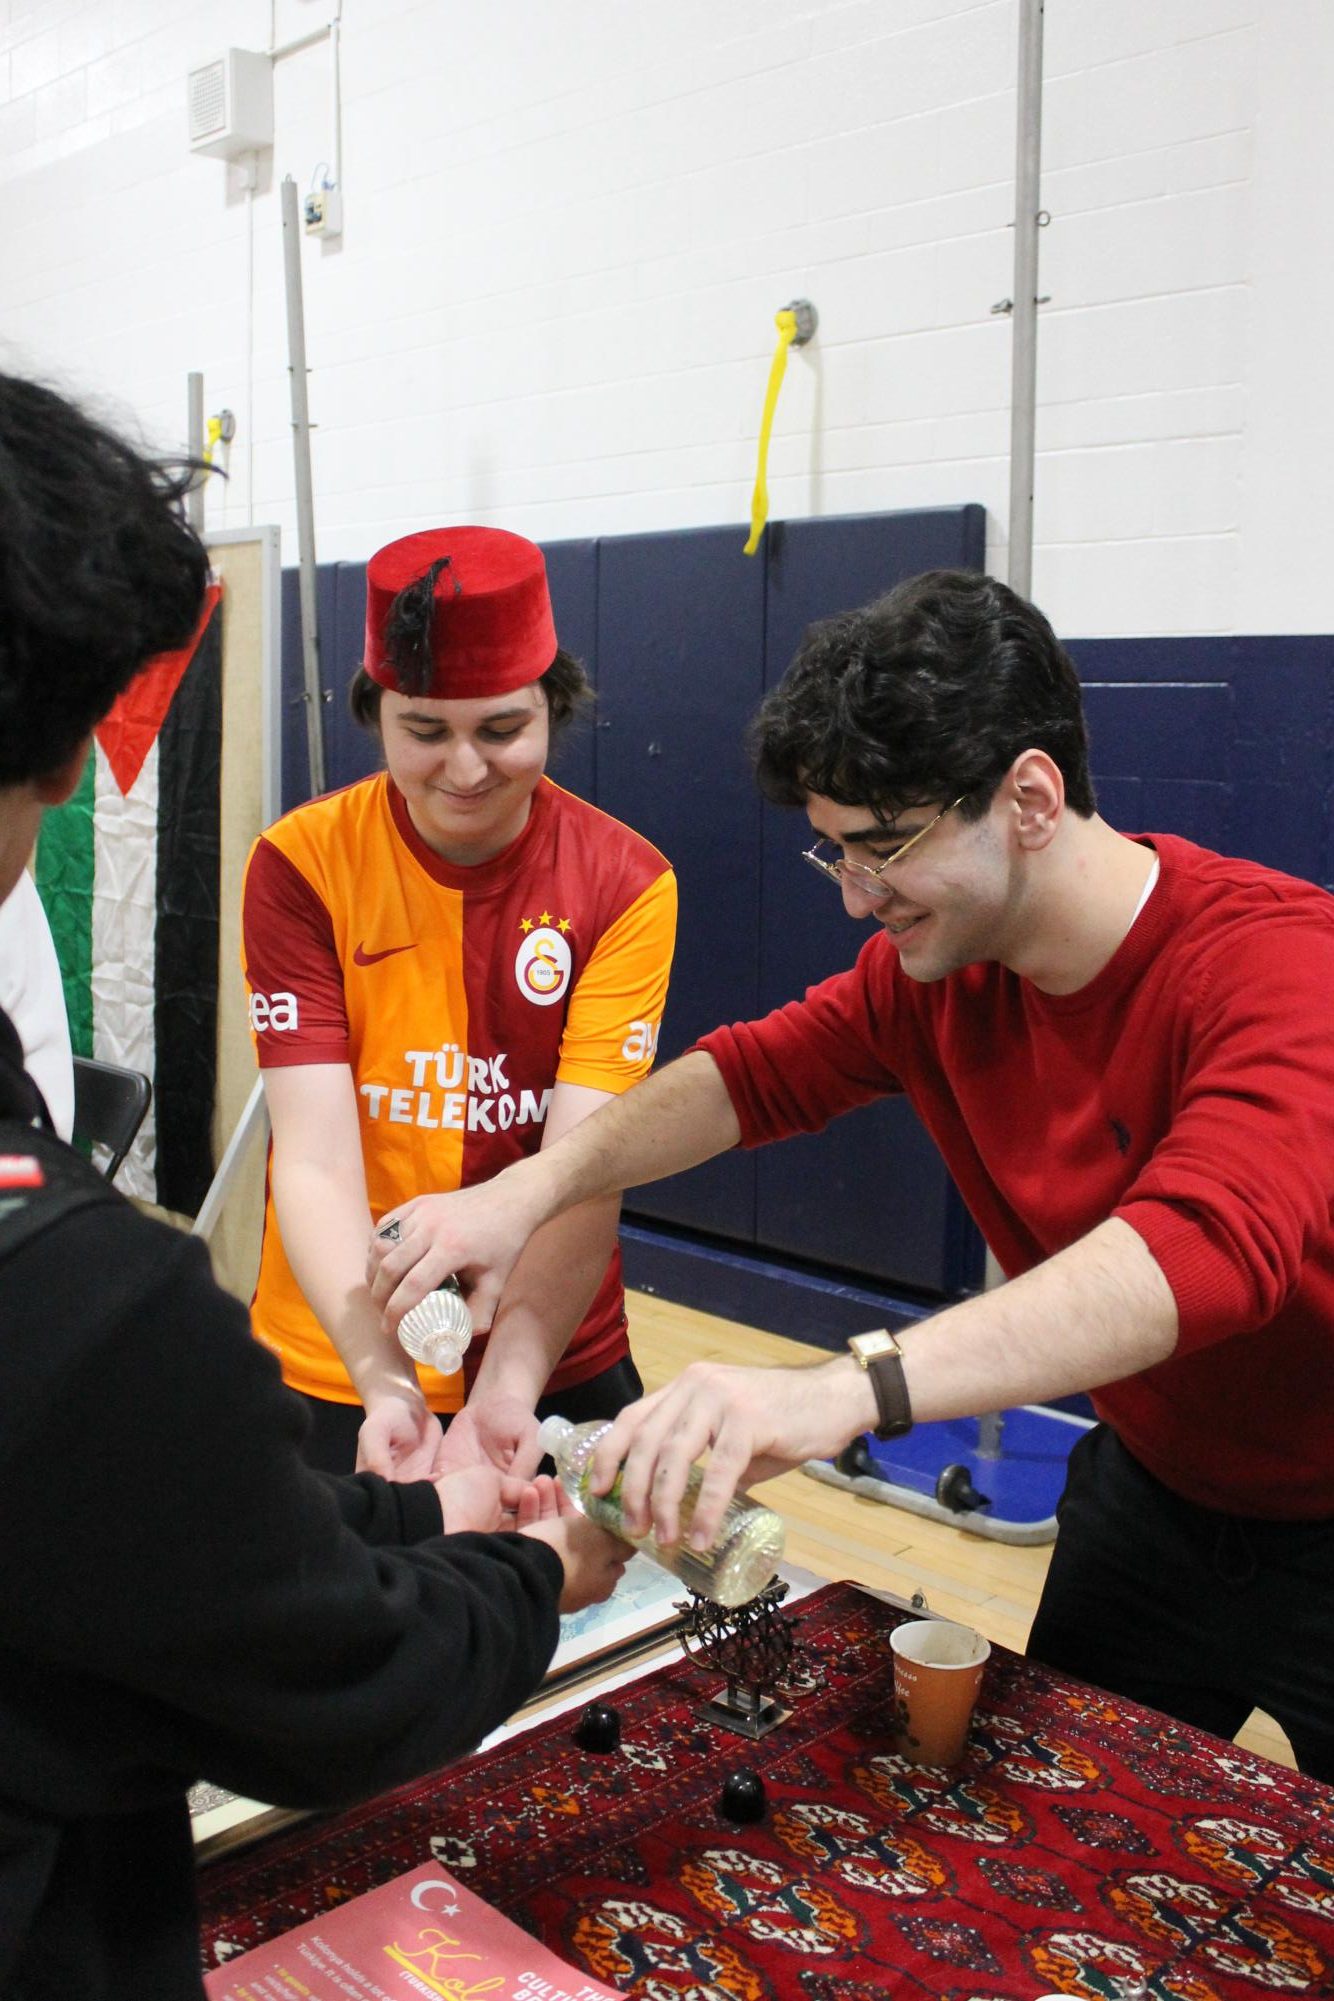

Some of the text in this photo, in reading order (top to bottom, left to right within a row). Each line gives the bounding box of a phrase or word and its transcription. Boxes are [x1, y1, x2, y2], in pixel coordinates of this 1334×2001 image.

[249, 992, 298, 1032] ea
[404, 1042, 510, 1095] TÜRK
[360, 1083, 556, 1134] TELEKOM
[517, 1971, 577, 2001] CULT
